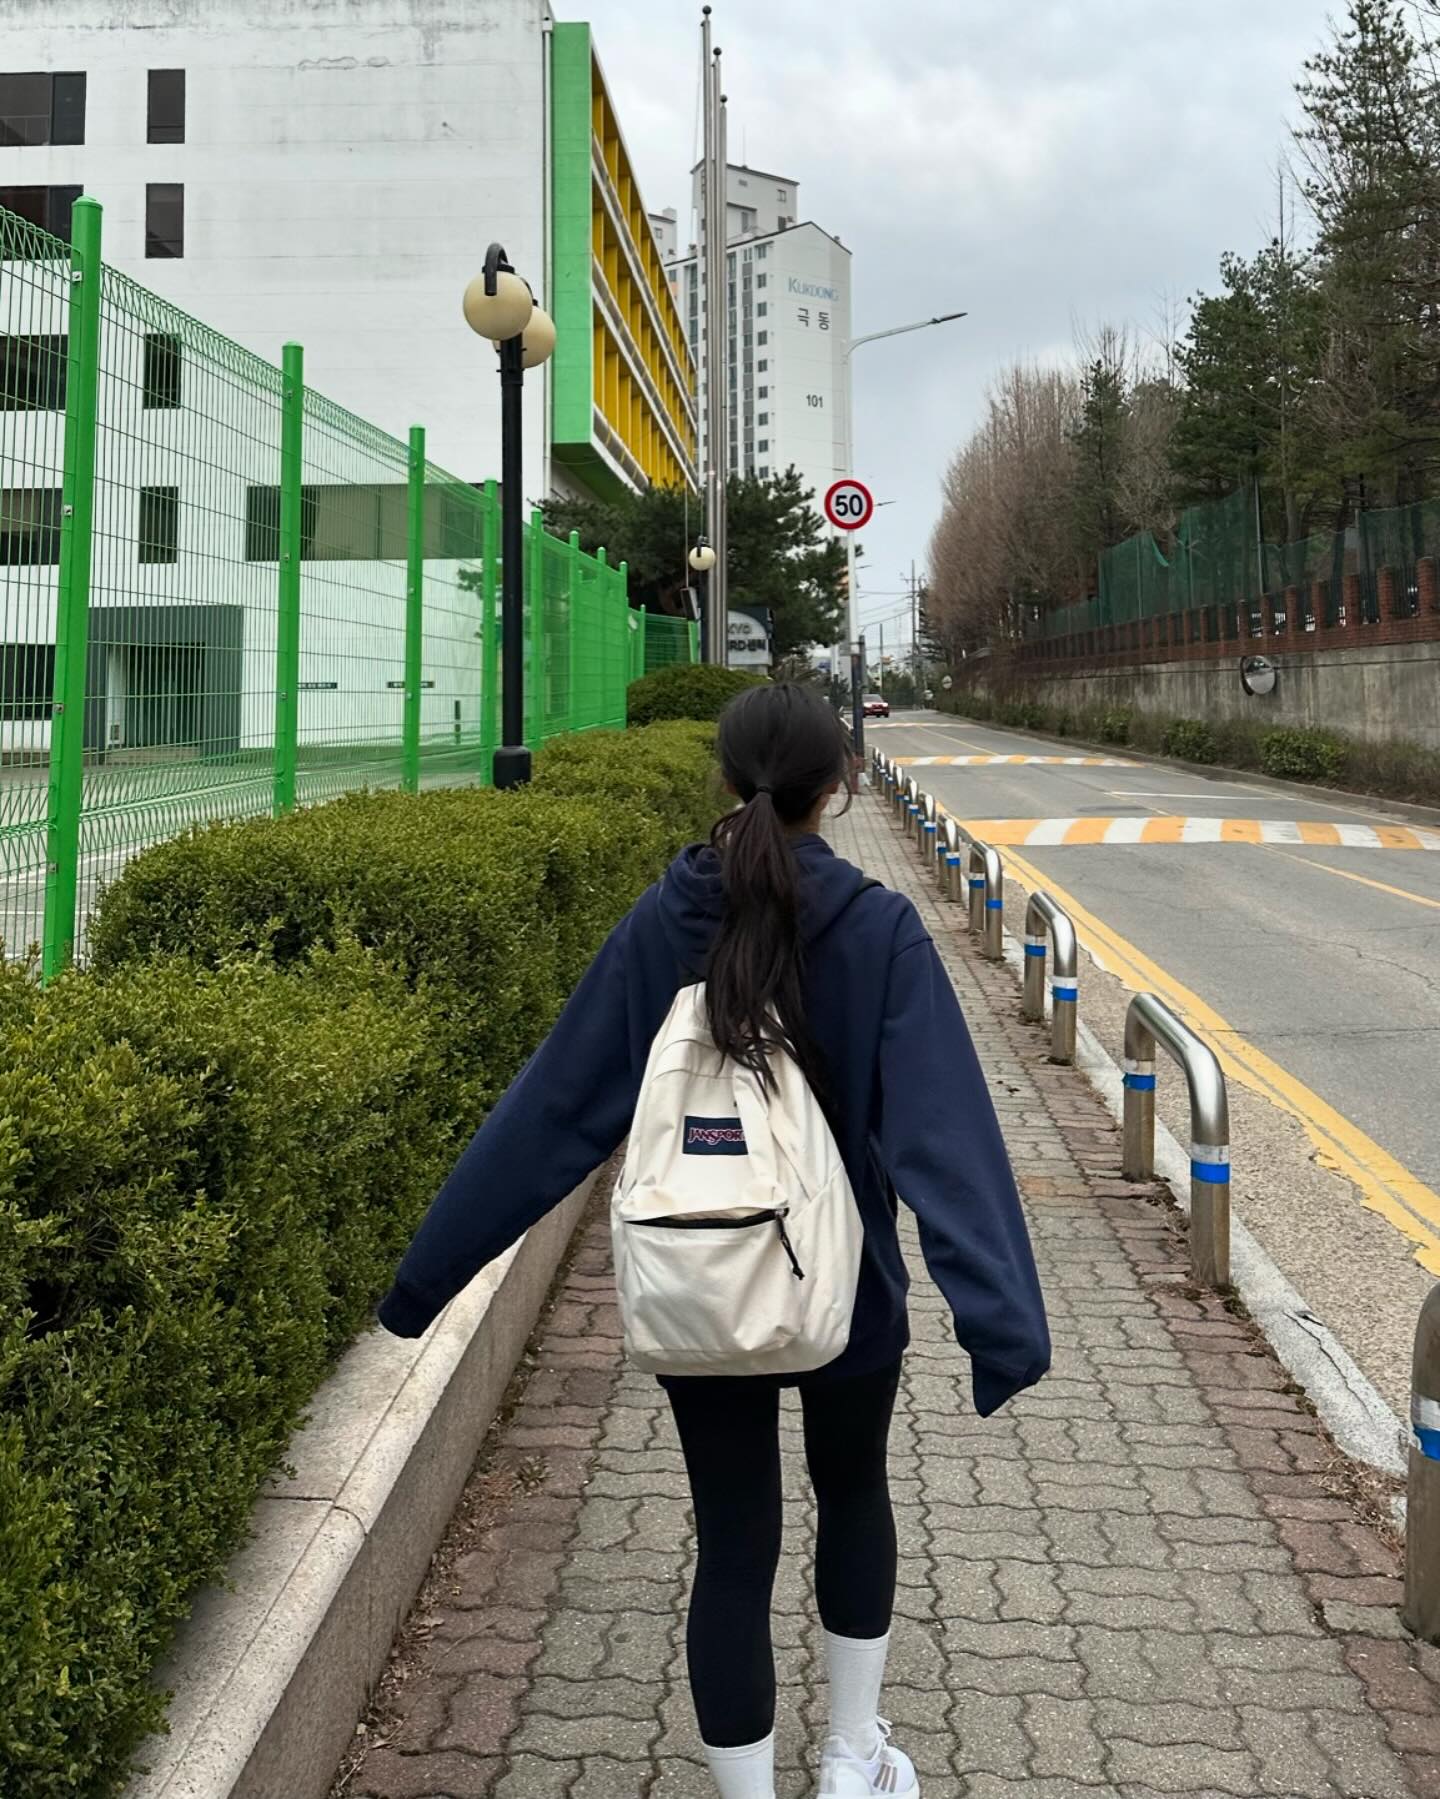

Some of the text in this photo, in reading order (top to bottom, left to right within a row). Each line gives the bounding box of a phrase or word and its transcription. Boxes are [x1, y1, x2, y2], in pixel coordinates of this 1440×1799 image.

[806, 394, 823, 409] 101
[835, 494, 863, 517] 50
[687, 1127, 746, 1146] JANSPOR
